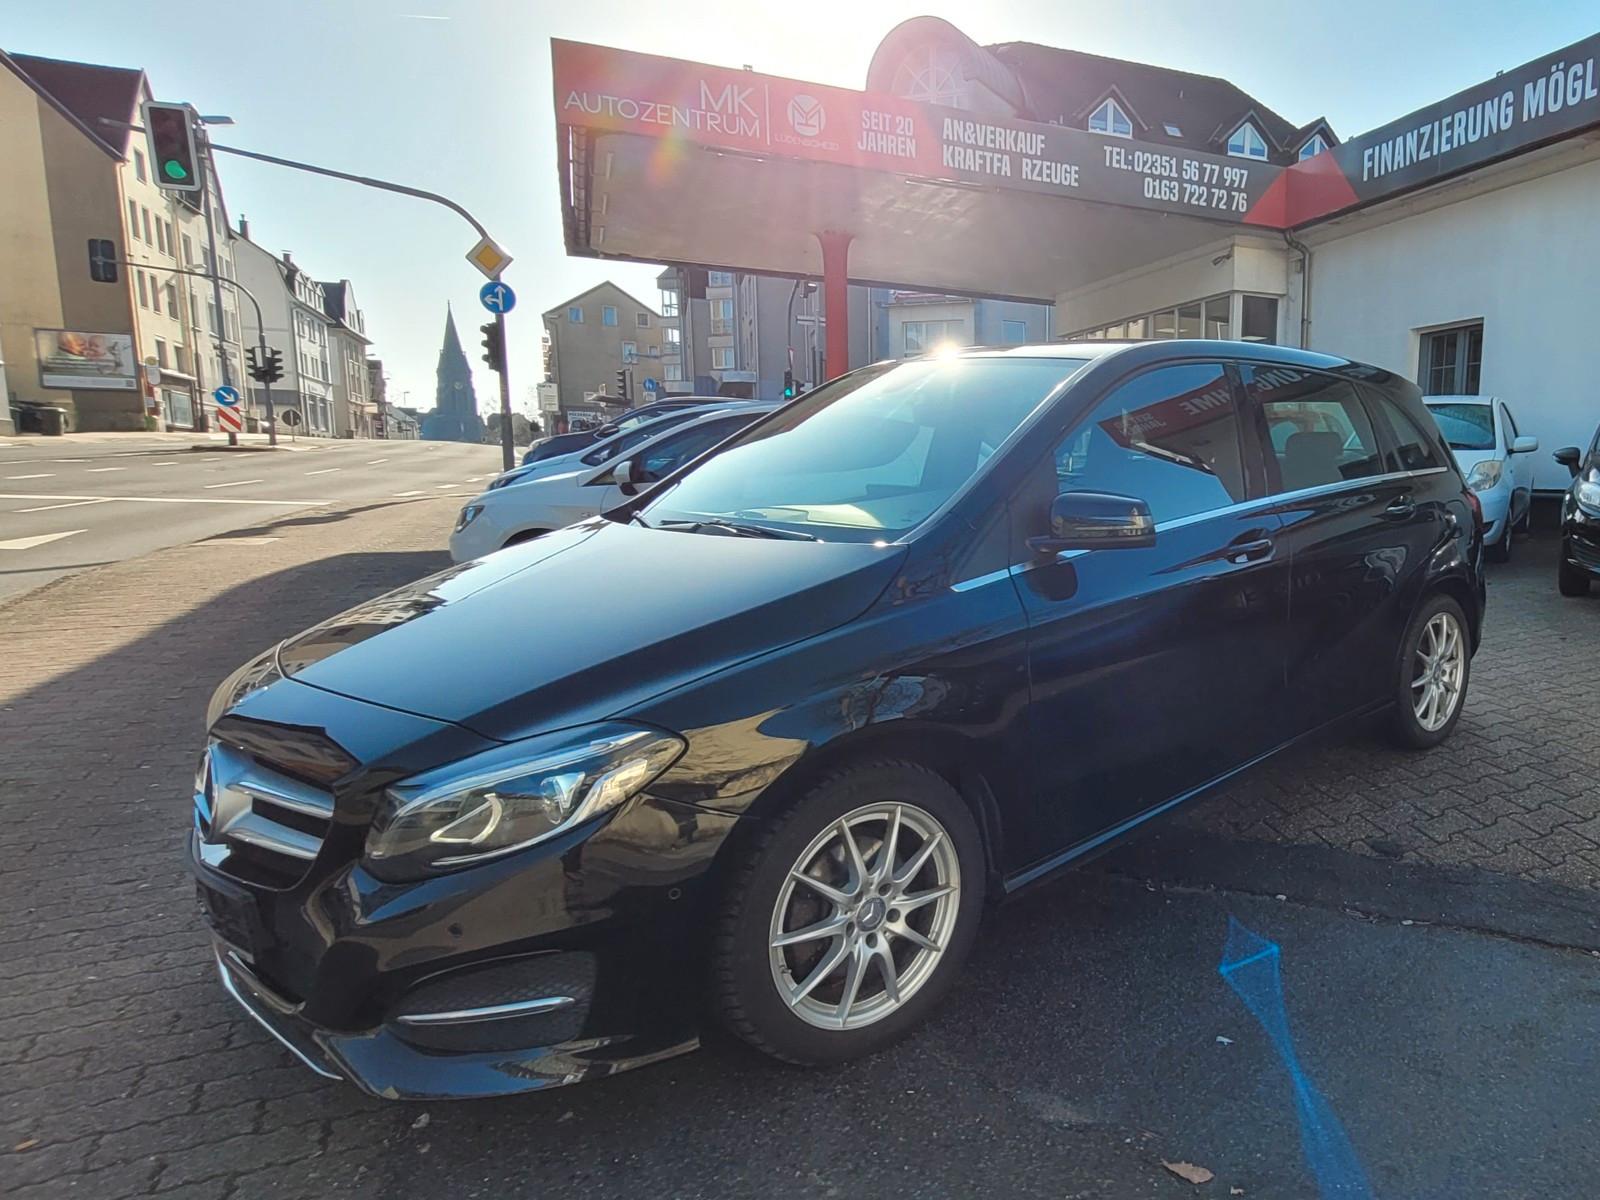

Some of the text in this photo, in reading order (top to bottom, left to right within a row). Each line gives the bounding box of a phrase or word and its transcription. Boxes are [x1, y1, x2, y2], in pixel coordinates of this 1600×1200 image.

[564, 90, 760, 138] AUTOZENTRUM
[700, 79, 758, 118] MK
[862, 110, 914, 137] SEIT 20
[943, 117, 1046, 156] AN&VERKAUF
[1363, 58, 1598, 182] FINANZIERUNG MÖGL
[857, 130, 917, 159] JAHREN
[1182, 159, 1200, 181] 56
[1202, 163, 1221, 185] 77
[1223, 166, 1249, 189] 997
[1143, 177, 1248, 213] 0163 722 72 76
